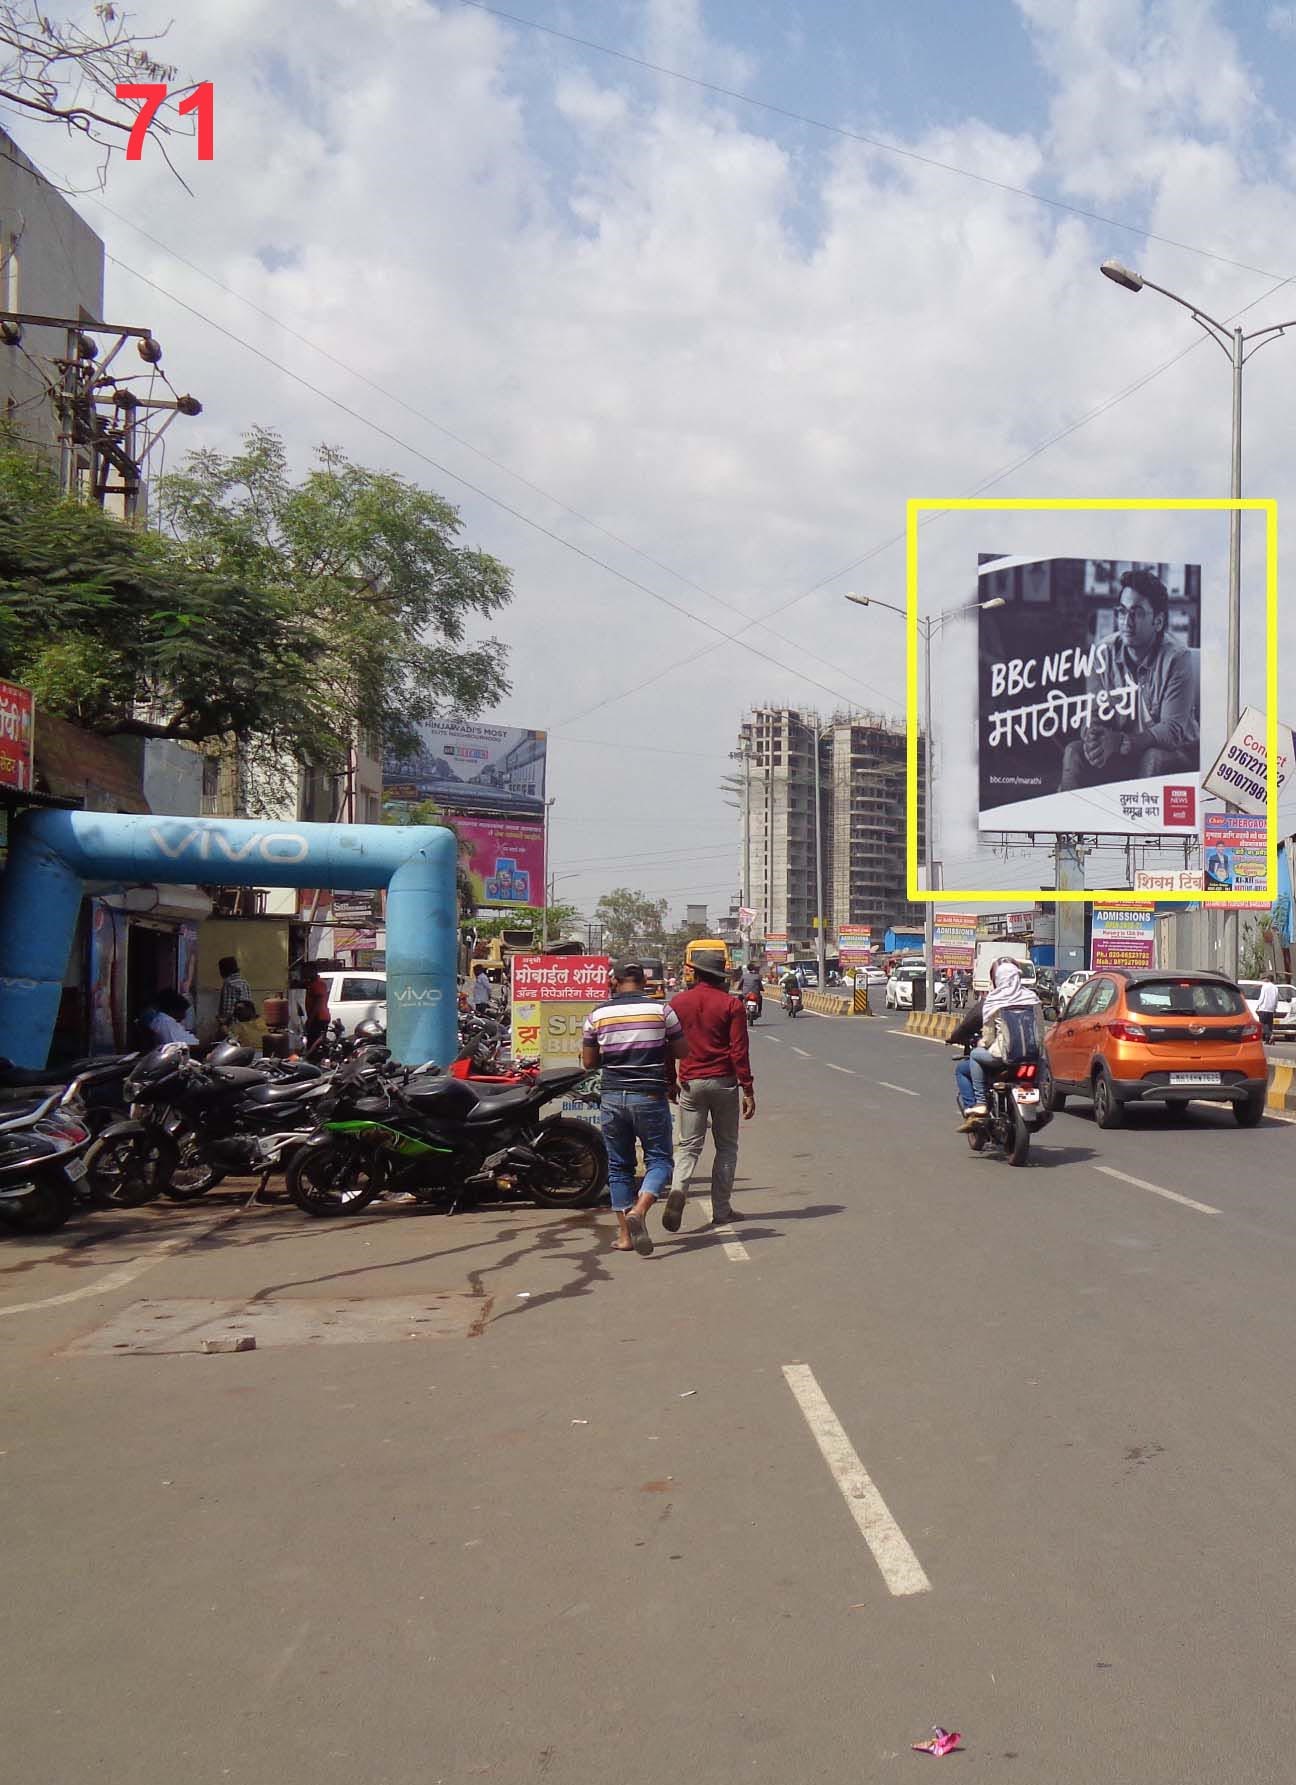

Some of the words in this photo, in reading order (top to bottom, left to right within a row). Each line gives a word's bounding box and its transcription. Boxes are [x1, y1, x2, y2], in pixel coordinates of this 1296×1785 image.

[991, 659, 1037, 697] BBC
[1041, 643, 1108, 686] NEWS
[988, 673, 1140, 747] मराठीमध्ये
[484, 727, 507, 738] MOST
[1243, 734, 1287, 768] Cont
[989, 775, 1042, 785] bbc.com/marathi
[1097, 911, 1151, 921] ADMISSIONS
[573, 963, 607, 985] शॉपी
[393, 985, 442, 1001] vivo
